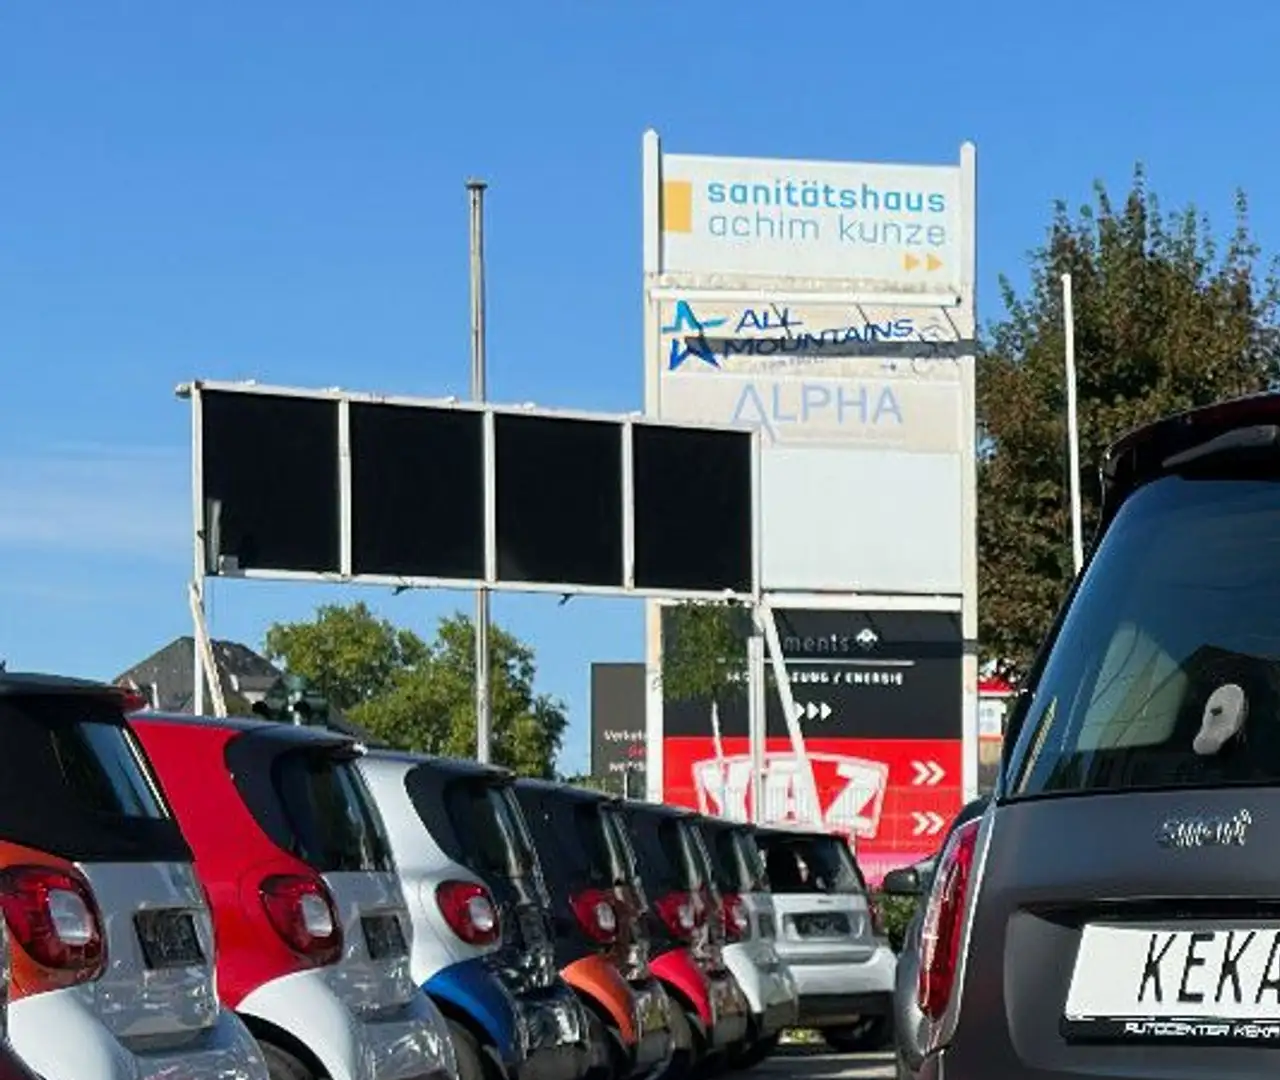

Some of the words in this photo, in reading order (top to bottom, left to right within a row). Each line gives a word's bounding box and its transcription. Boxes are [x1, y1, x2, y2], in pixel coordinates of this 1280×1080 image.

[707, 178, 946, 213] sanitätshaus
[708, 211, 819, 240] achim
[838, 213, 947, 247] kunze
[722, 318, 914, 358] MOUNTAINS
[728, 382, 904, 443] ALPHA
[782, 633, 850, 652] ments
[1124, 1022, 1231, 1036] AUTOCENTER
[1233, 1024, 1280, 1038] KEKA
